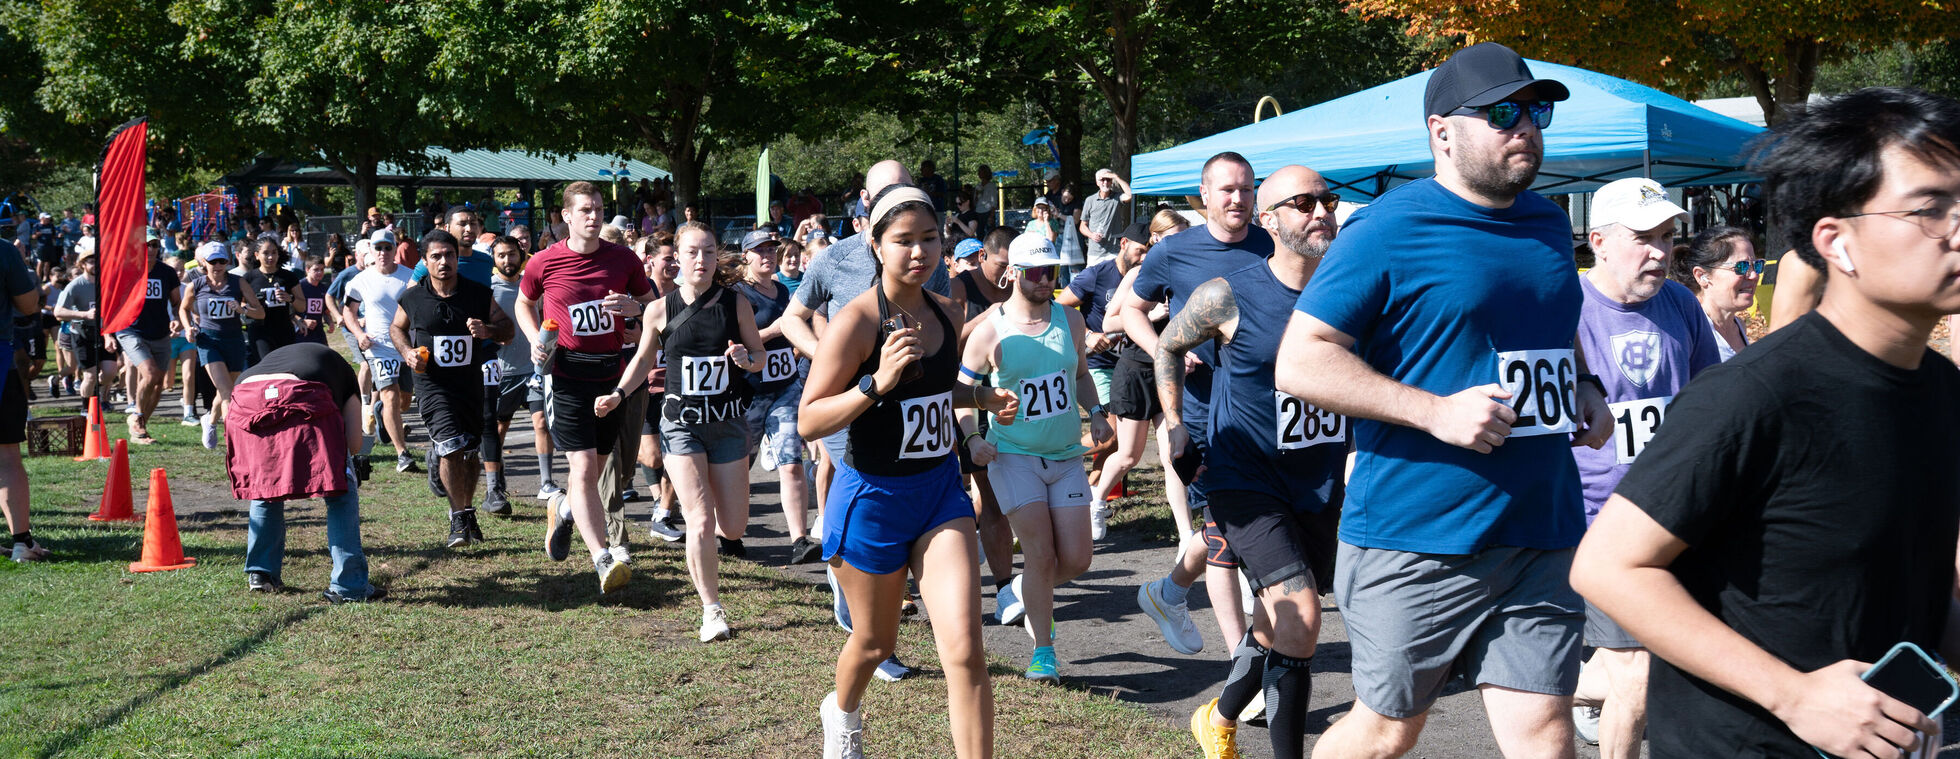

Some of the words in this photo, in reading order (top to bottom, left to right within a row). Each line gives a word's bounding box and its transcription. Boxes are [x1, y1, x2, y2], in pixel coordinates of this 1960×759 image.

[310, 300, 322, 312] 52
[572, 304, 612, 333] 205
[440, 339, 467, 364] 39
[767, 352, 792, 378] 68
[376, 359, 399, 378] 292
[685, 361, 725, 392] 127
[1024, 375, 1068, 416] 213
[1506, 357, 1577, 428] 266
[904, 398, 951, 453] 296
[1281, 397, 1342, 443] 285
